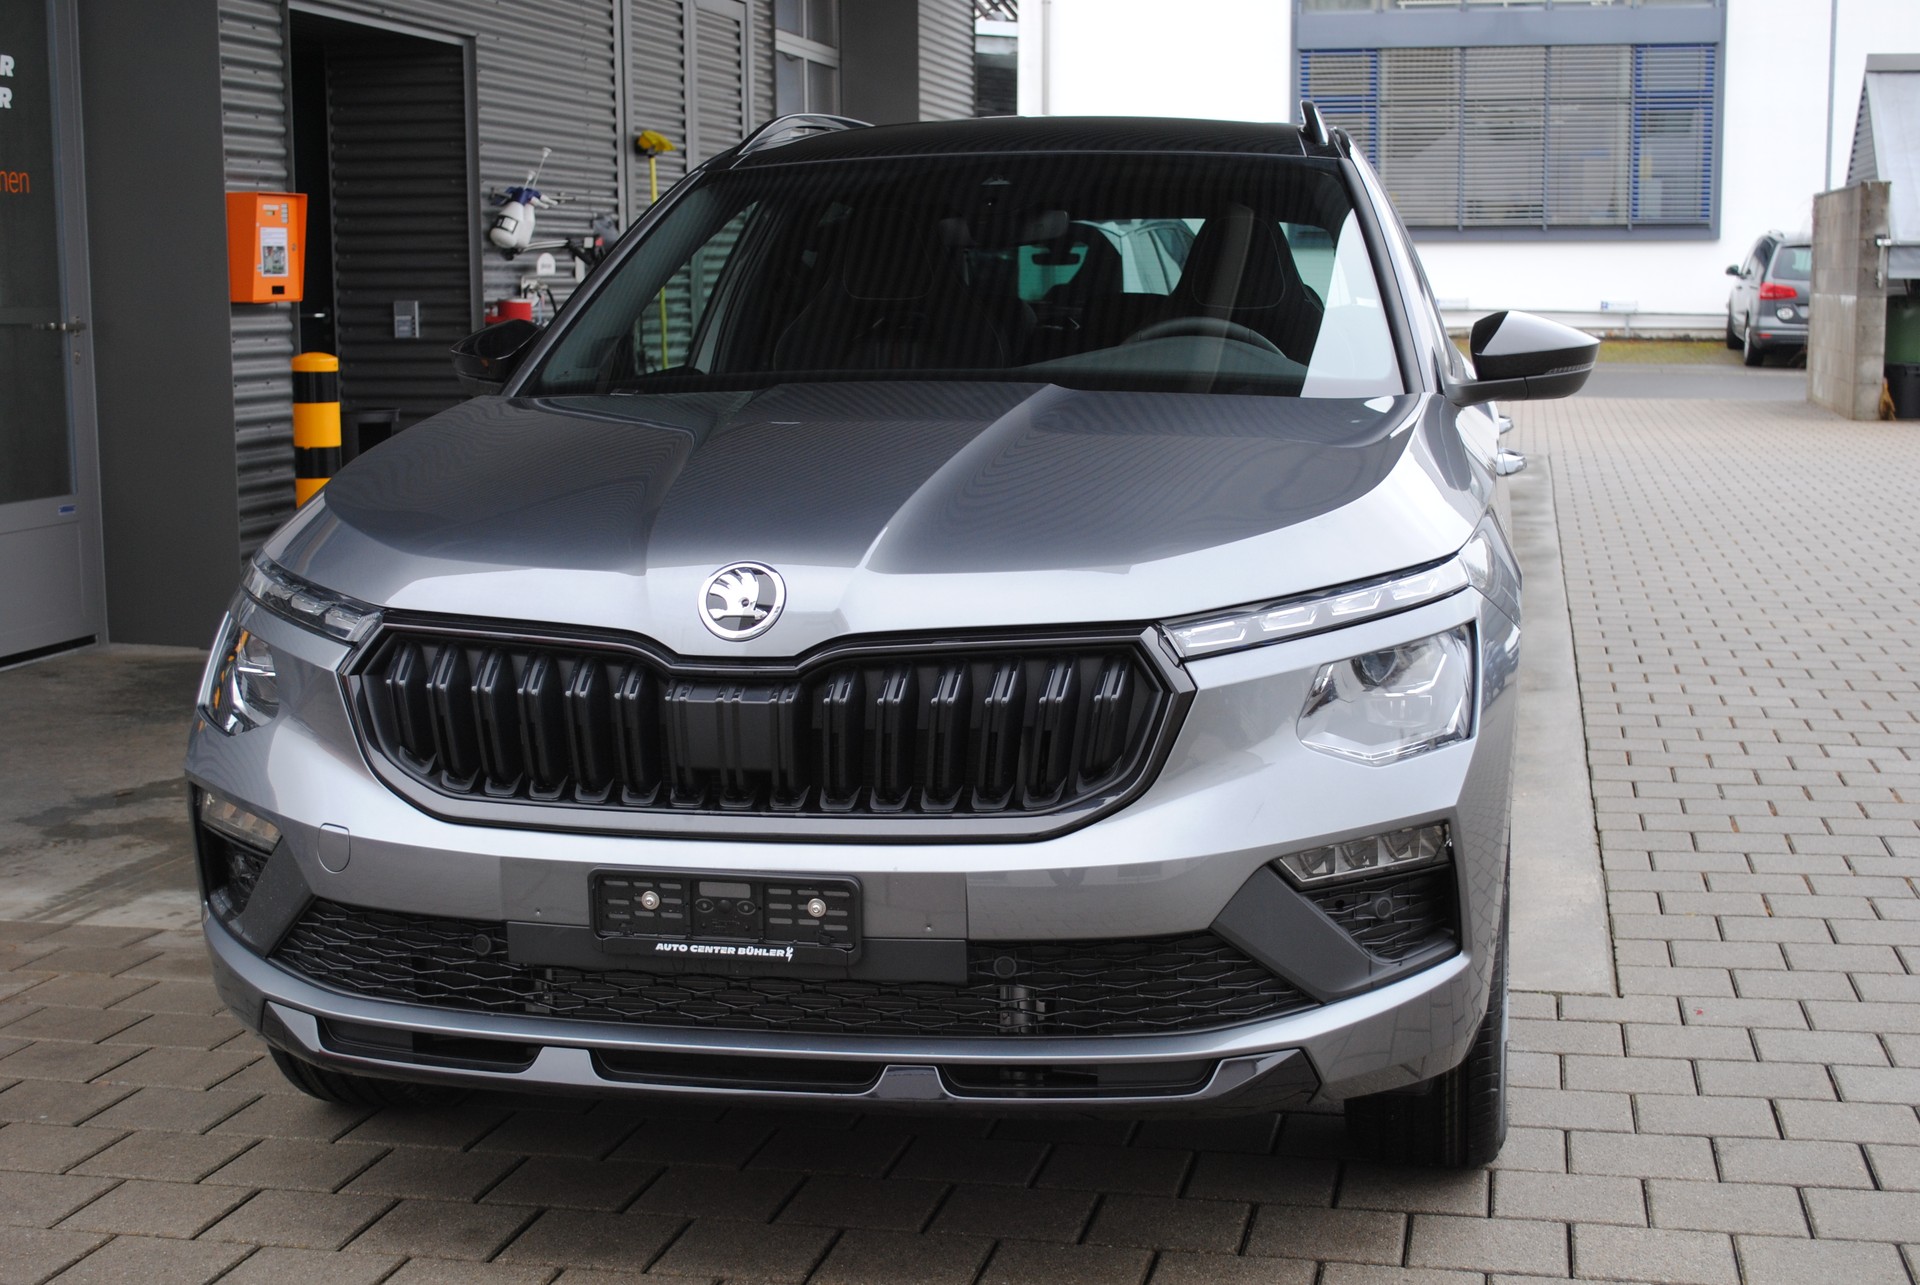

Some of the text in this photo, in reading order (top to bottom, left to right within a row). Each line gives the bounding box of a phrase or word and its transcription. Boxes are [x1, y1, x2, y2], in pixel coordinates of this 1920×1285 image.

[655, 943, 785, 957] AUTO CENTER BÜHLER
